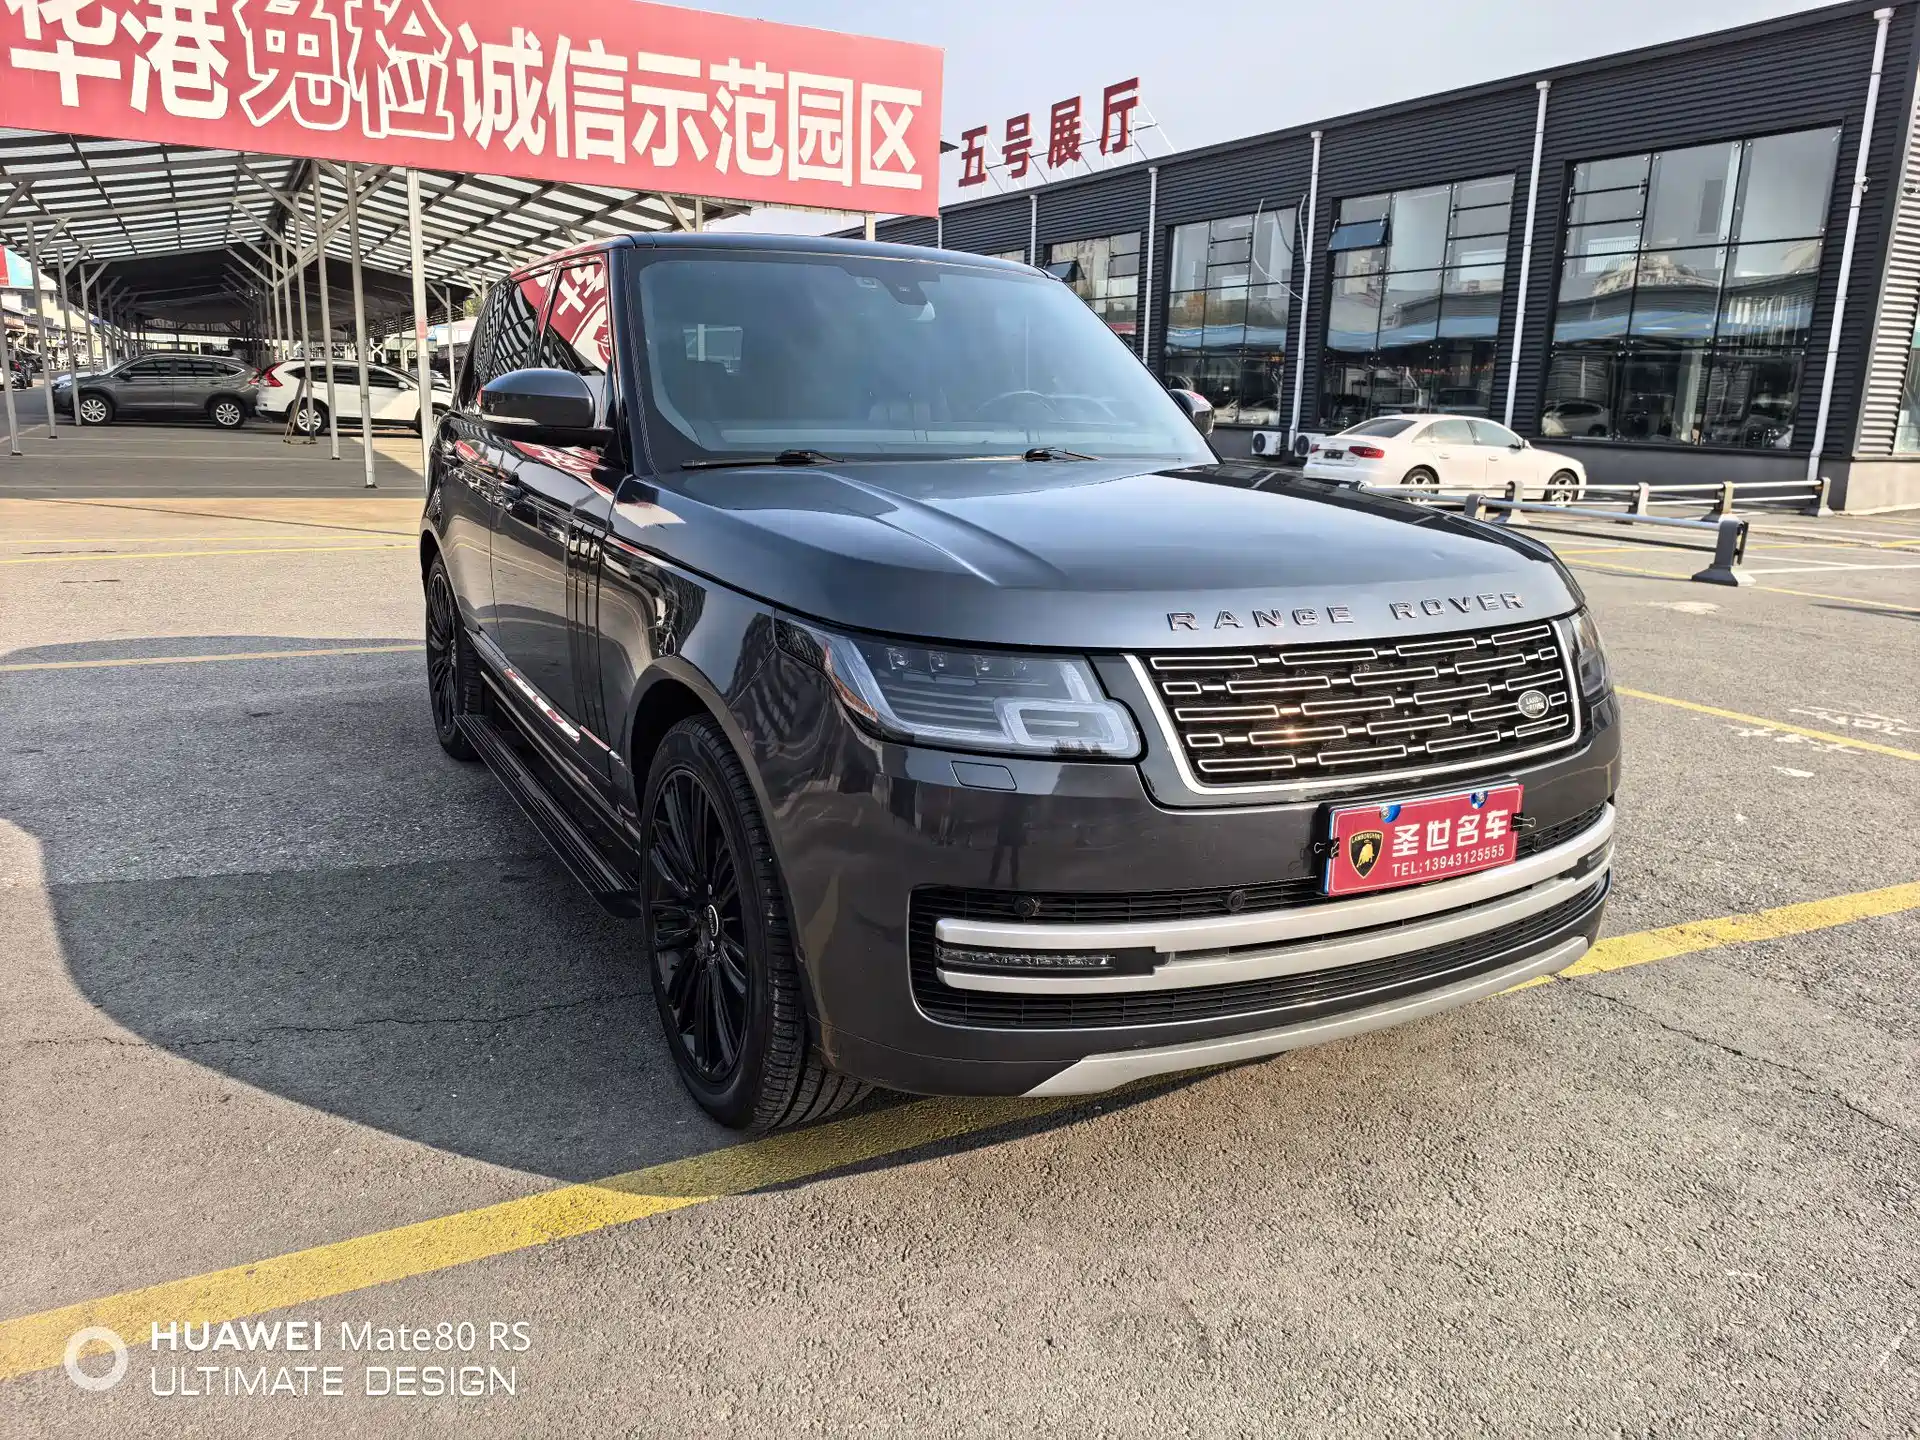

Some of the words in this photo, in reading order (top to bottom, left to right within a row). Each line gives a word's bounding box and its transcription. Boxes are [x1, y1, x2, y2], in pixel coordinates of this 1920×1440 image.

[1, 0, 924, 189] 华港免检诚信示范园区
[958, 77, 1139, 187] 五号展厅
[1166, 604, 1354, 631] RANGE
[1389, 591, 1526, 620] ROVER
[1392, 809, 1509, 858] 圣世名车
[1392, 844, 1505, 877] TEL:13943125555
